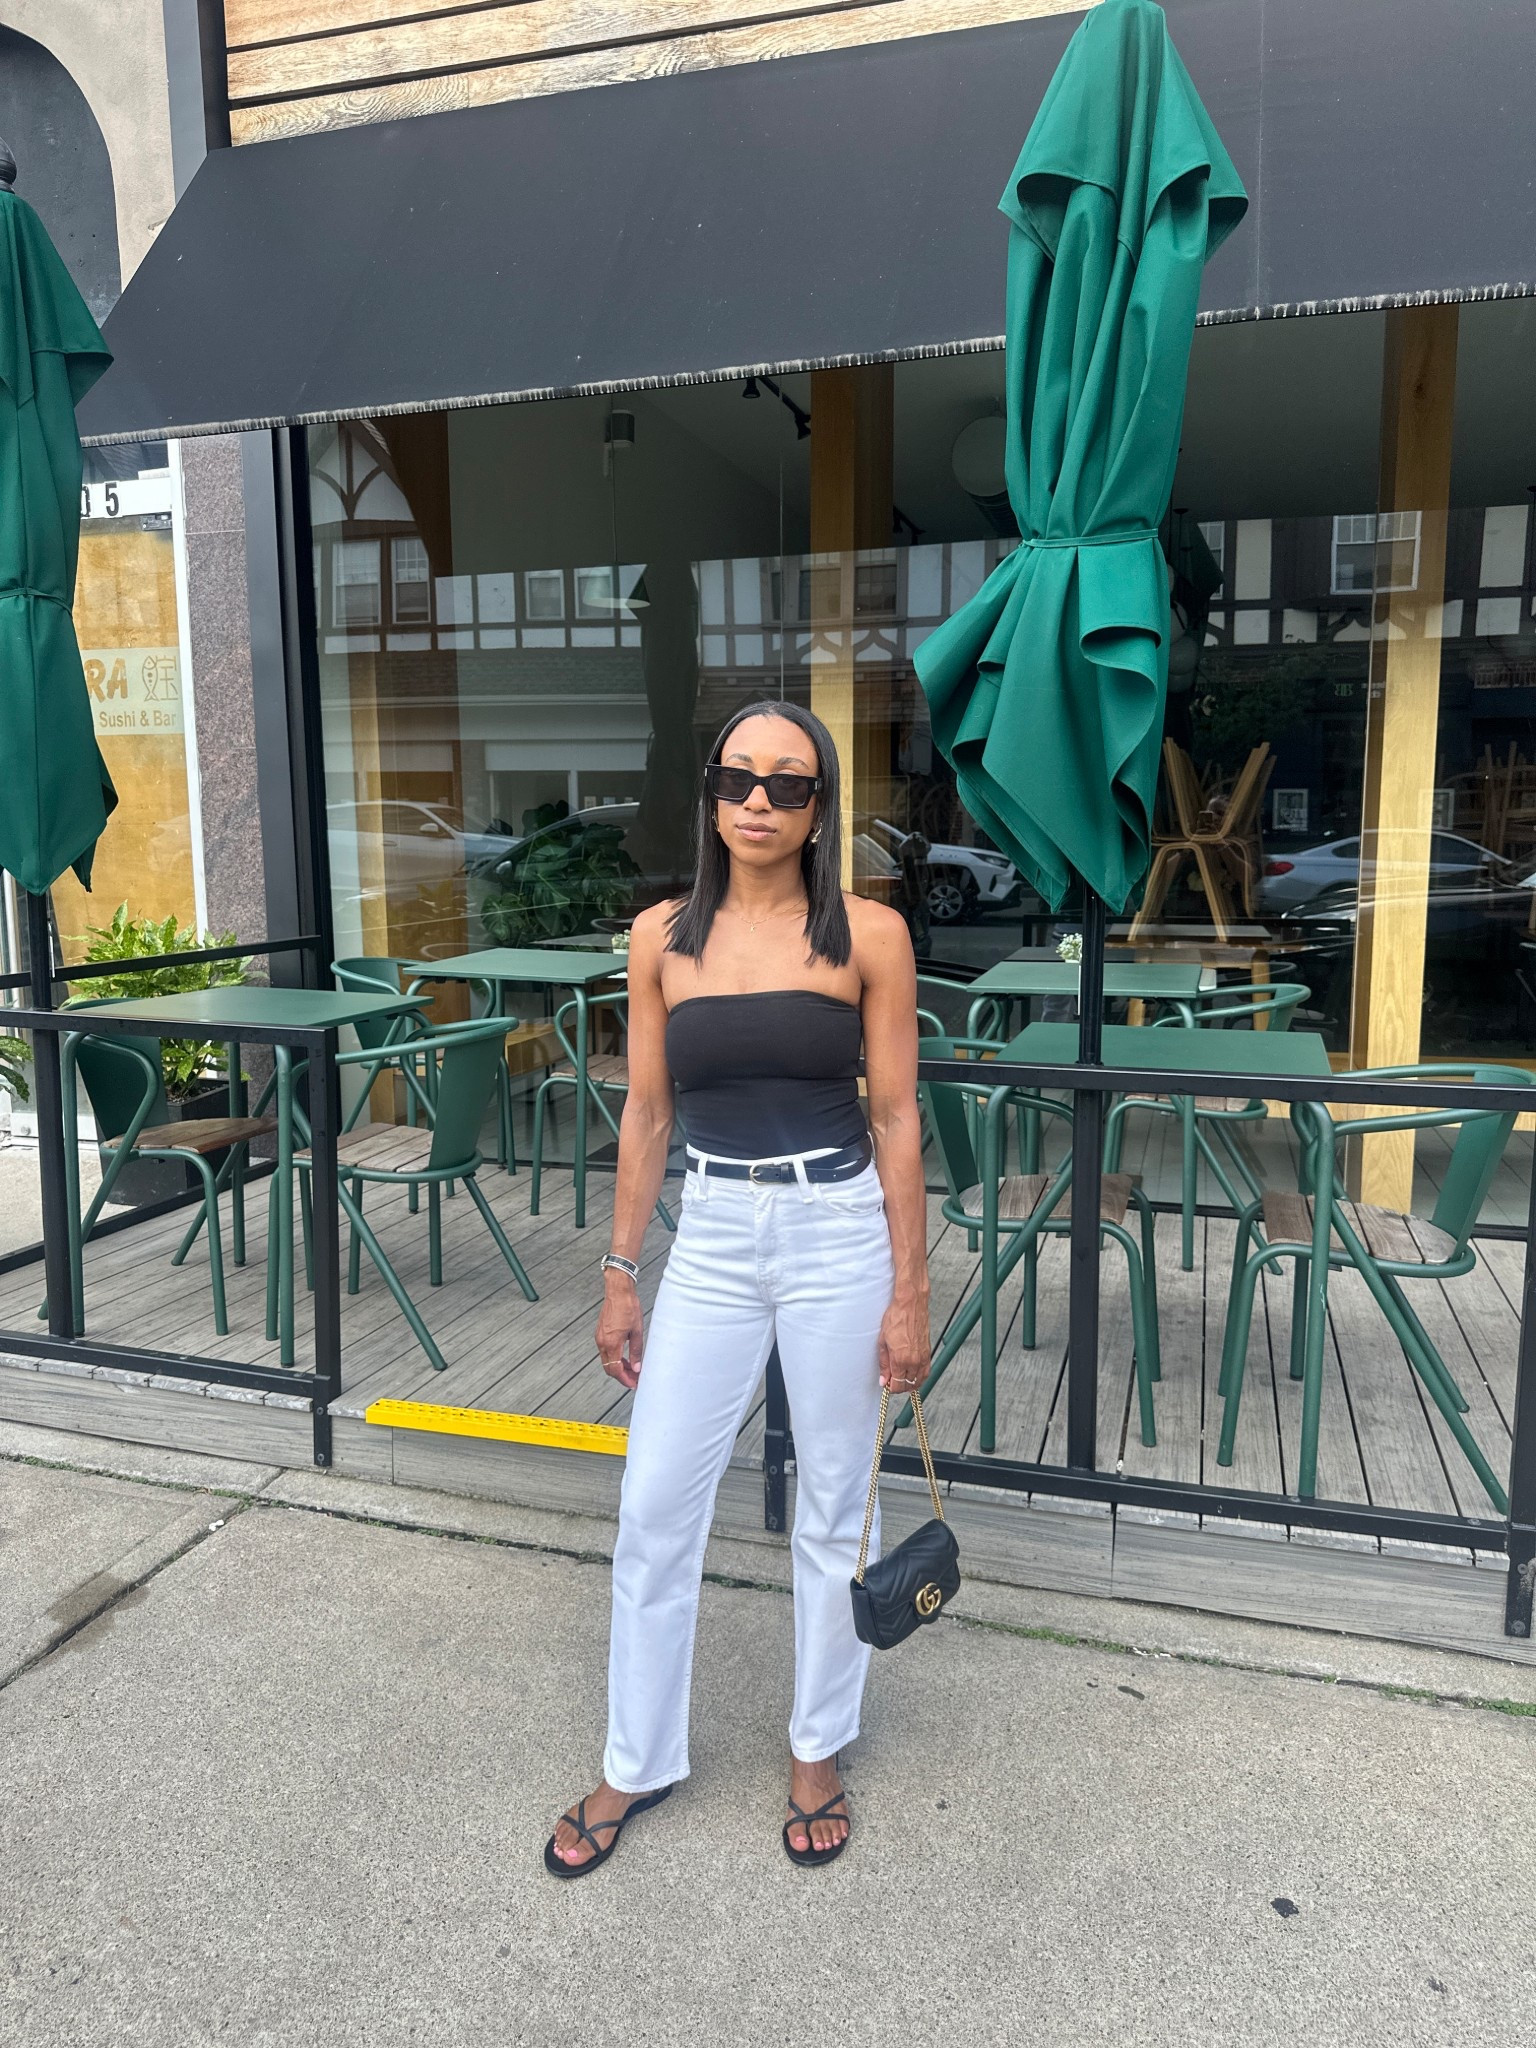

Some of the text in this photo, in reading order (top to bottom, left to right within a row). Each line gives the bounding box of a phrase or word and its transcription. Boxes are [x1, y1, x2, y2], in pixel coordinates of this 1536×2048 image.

[99, 710, 176, 728] Sushi & Bar
